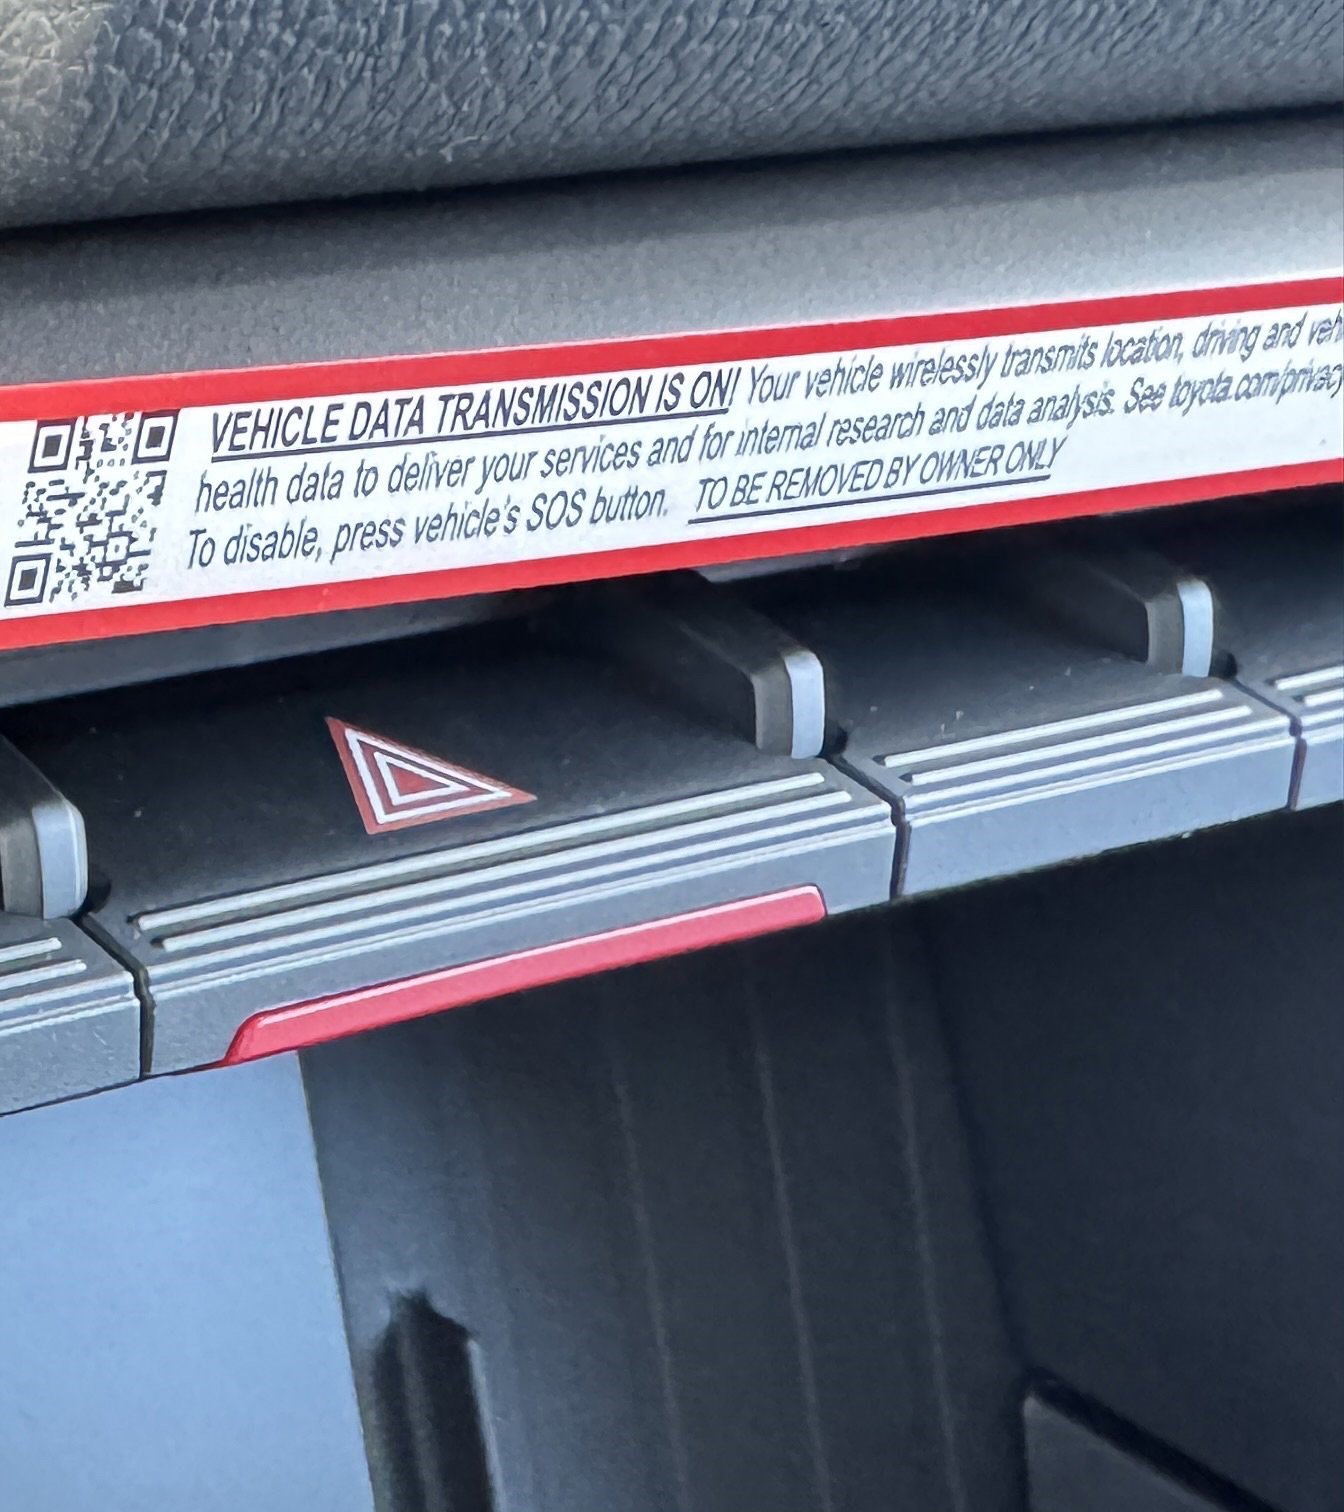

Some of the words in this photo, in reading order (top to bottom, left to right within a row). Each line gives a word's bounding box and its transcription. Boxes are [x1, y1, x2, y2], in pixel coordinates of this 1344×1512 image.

[195, 466, 278, 513] health
[286, 461, 345, 504] data
[353, 459, 379, 498] to
[387, 450, 476, 495] deliver
[475, 450, 538, 495] your
[540, 434, 642, 478] services
[647, 424, 699, 468] and
[699, 422, 734, 461] for
[735, 411, 827, 457] internal
[827, 402, 925, 447] research
[928, 394, 978, 436] and
[976, 392, 1025, 431] data
[1124, 377, 1167, 414] See
[212, 402, 344, 453] VEHICLE
[348, 394, 425, 441] DATA
[437, 374, 653, 433] TRANSMISSION
[655, 372, 685, 413] IS
[748, 363, 801, 405] Your
[805, 354, 884, 399] vehicle
[889, 343, 998, 390] wirelessly
[1000, 333, 1098, 378] transmits
[1100, 325, 1184, 369] location,
[1192, 318, 1262, 363] driving
[1263, 310, 1308, 351] and
[187, 528, 216, 569] To
[224, 516, 323, 565] disable,
[330, 515, 407, 564] press
[414, 495, 520, 545] vehicle's
[526, 488, 586, 532] SOS
[589, 485, 669, 525] button.
[696, 477, 728, 512] TO
[729, 471, 767, 507] BE
[765, 458, 884, 503] REMOVED
[883, 453, 921, 489] BY
[919, 444, 1006, 485] OWNER
[1005, 435, 1069, 474] ONLY
